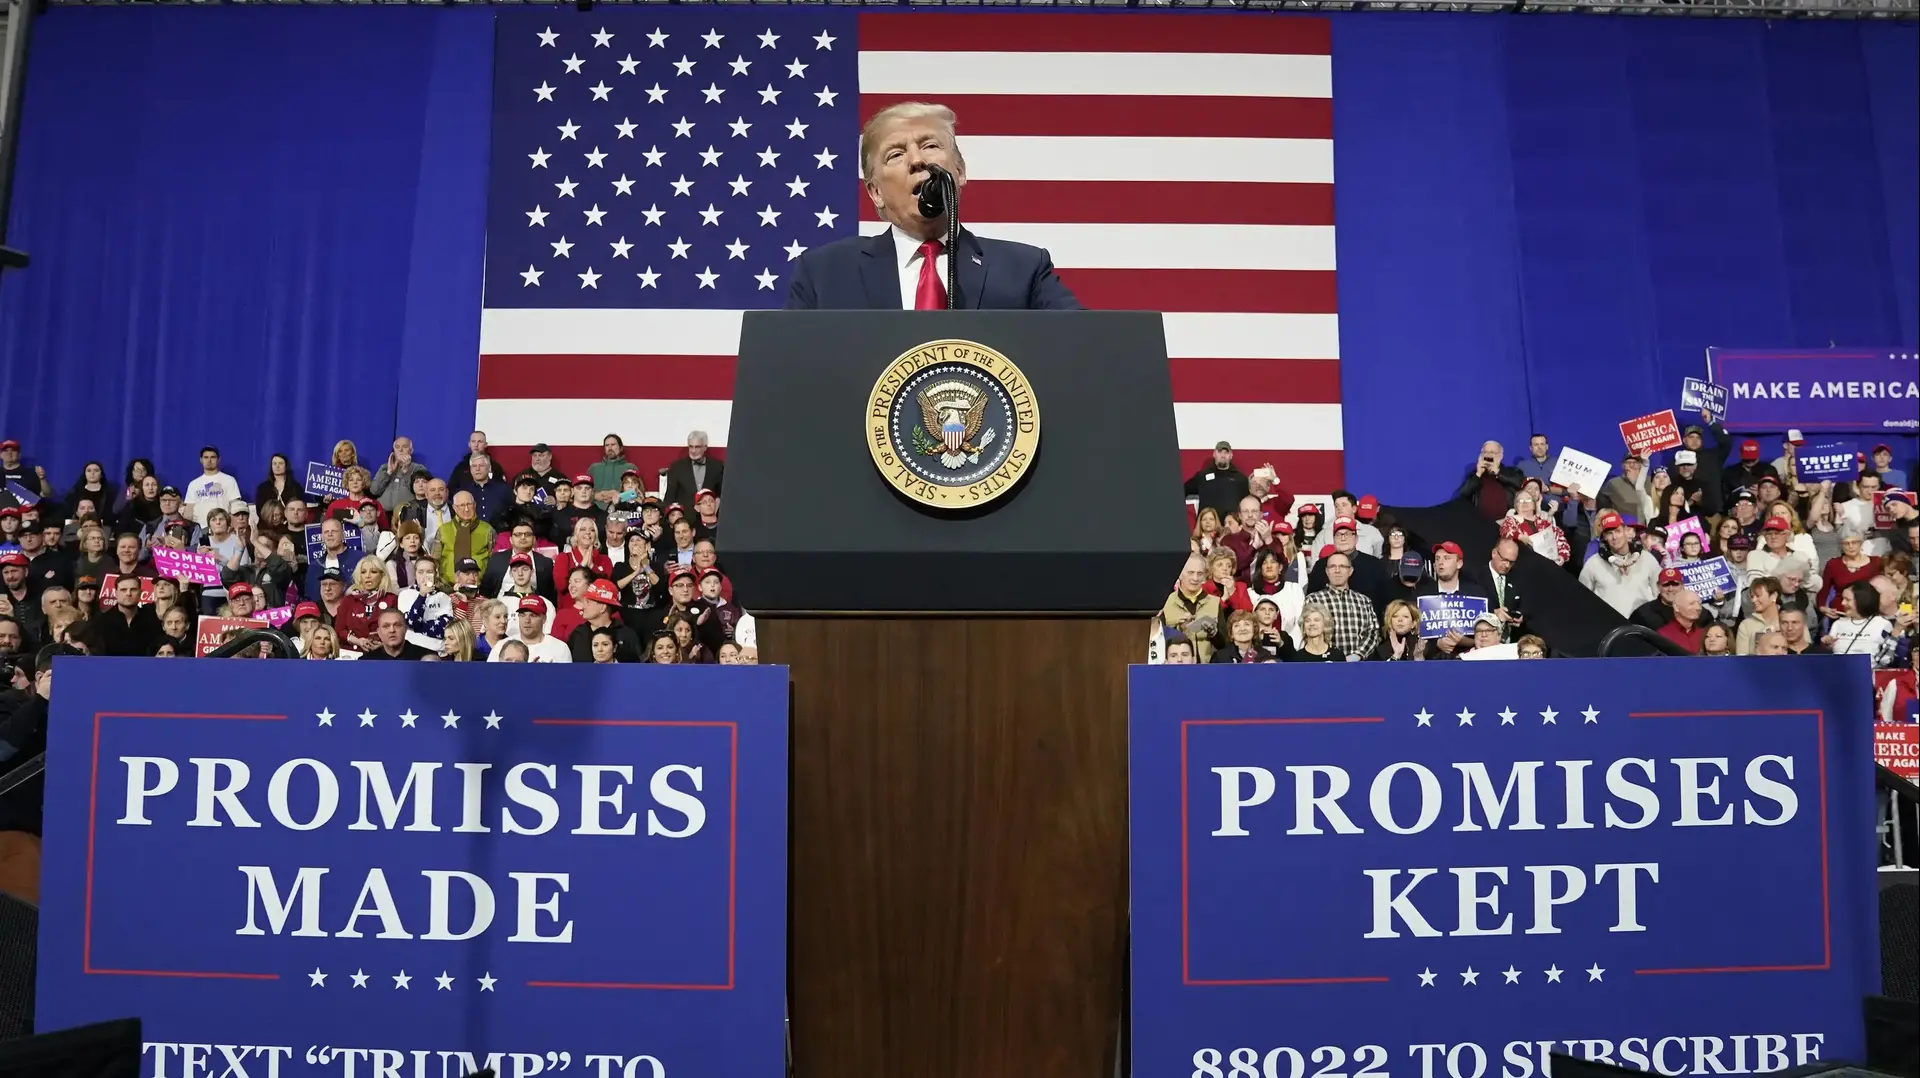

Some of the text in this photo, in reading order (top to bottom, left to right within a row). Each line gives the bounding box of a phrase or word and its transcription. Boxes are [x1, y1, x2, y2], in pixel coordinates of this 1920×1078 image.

[1691, 381, 1724, 399] DRAIN
[1702, 392, 1714, 402] THE
[1732, 381, 1919, 399] MAKE AMERICA
[1685, 397, 1724, 414] SWAMP
[873, 346, 1034, 500] SEAL OF THE PRESIDENT OF THE UNITED STATES
[1636, 419, 1656, 430] MAKE
[1626, 423, 1676, 444] AMERICA
[1631, 433, 1675, 451] GREAT AGAIN
[1800, 453, 1853, 466] TRUMP
[1805, 461, 1849, 471] PENCE
[309, 473, 343, 487] AMERI
[325, 470, 342, 478] MAKE
[312, 482, 349, 497] SAFE AGAIN
[1667, 519, 1701, 538] MEN
[154, 547, 216, 566] WOMEN
[175, 561, 198, 571] FOR
[161, 566, 217, 583] TRUMP
[102, 588, 155, 601] AMCA
[255, 608, 292, 621] MEN
[222, 624, 246, 632] MAK
[1426, 622, 1448, 631] SAFE
[1876, 732, 1906, 741] MAKE
[1873, 743, 1919, 757] ERIC
[1893, 758, 1919, 768] AGAI
[116, 756, 706, 838] PROMISES
[1210, 754, 1799, 837] PROMISES
[235, 865, 574, 944] MADE
[1362, 862, 1659, 939] KEPT
[142, 1042, 293, 1078] TEXT
[585, 1054, 667, 1078] TO
[1191, 1044, 1390, 1078] 88022
[1409, 1042, 1487, 1078] TO
